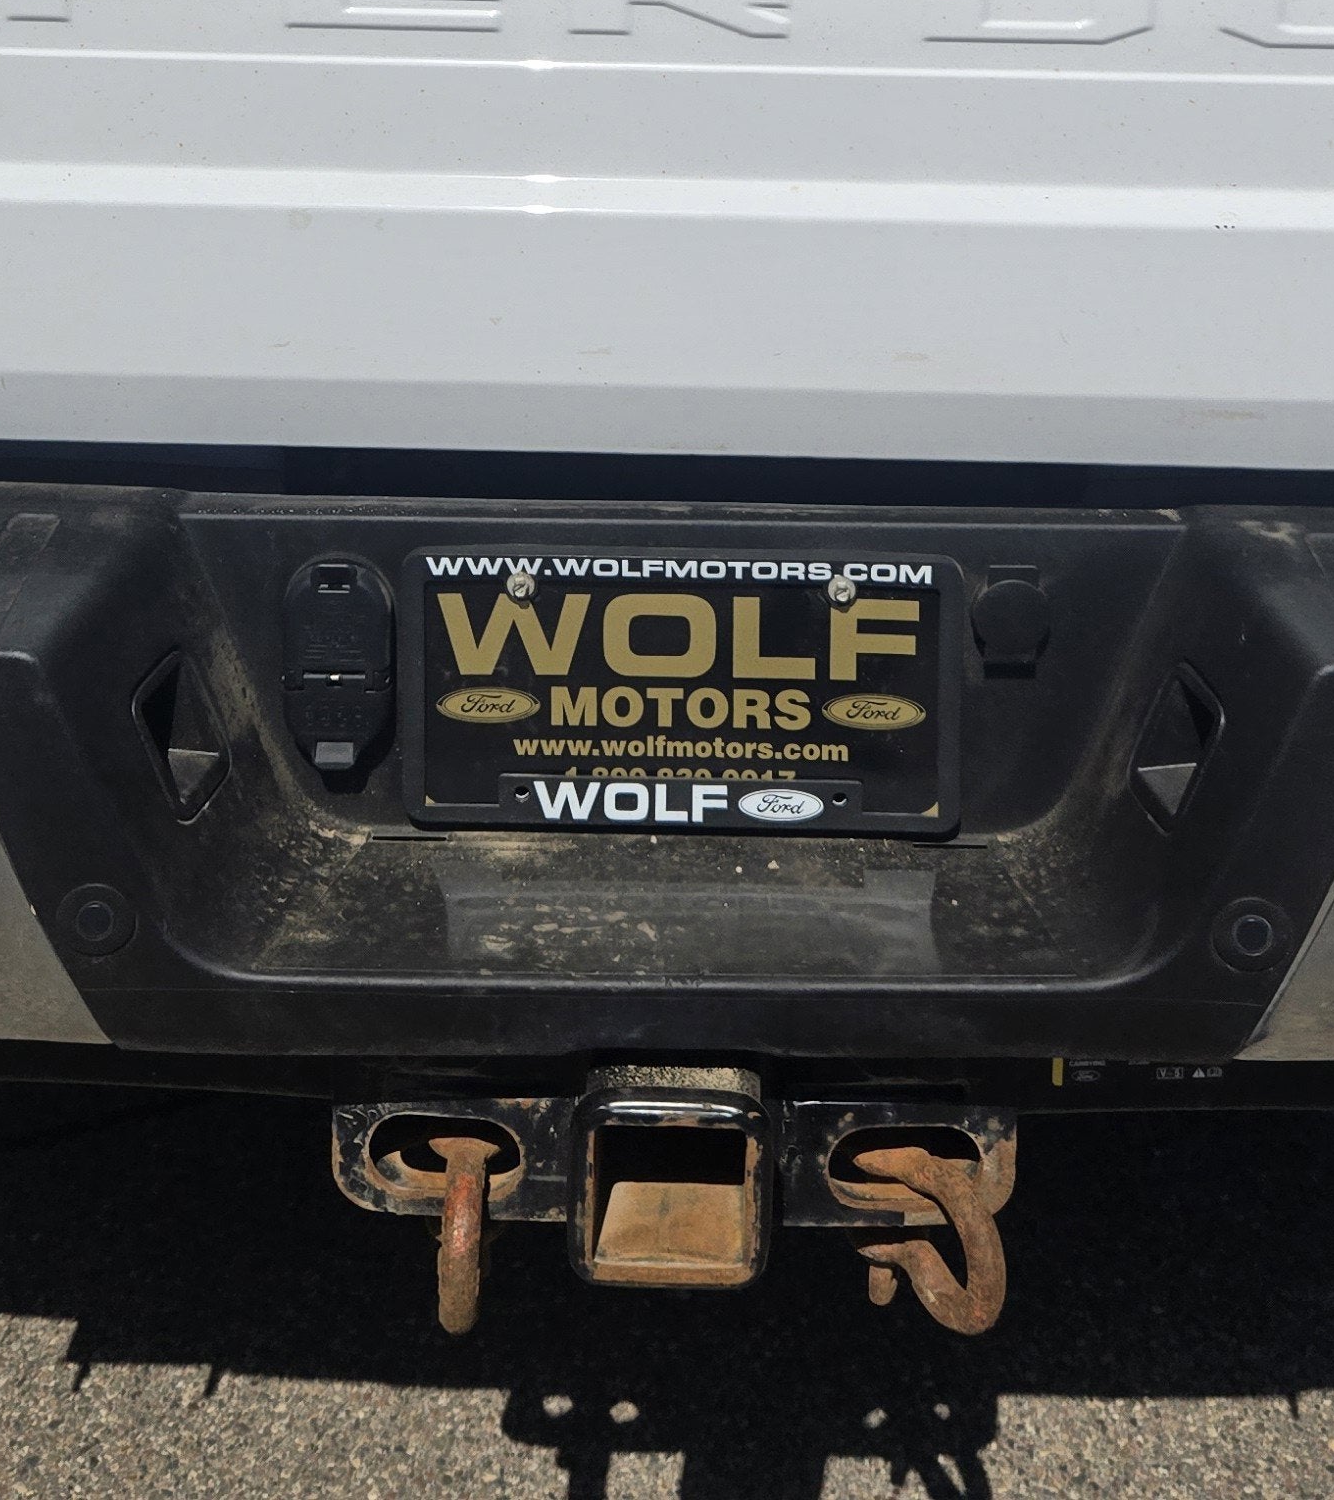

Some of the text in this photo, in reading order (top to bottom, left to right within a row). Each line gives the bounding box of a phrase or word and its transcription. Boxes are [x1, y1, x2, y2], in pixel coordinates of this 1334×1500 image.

[425, 556, 932, 585] WWW.WOLFMOTORS.COM
[436, 592, 920, 681] WOLF
[460, 686, 901, 731] Ford MOTORS Ford
[513, 735, 849, 762] www.wolfmotors.com
[533, 780, 806, 823] WOLF Ford
